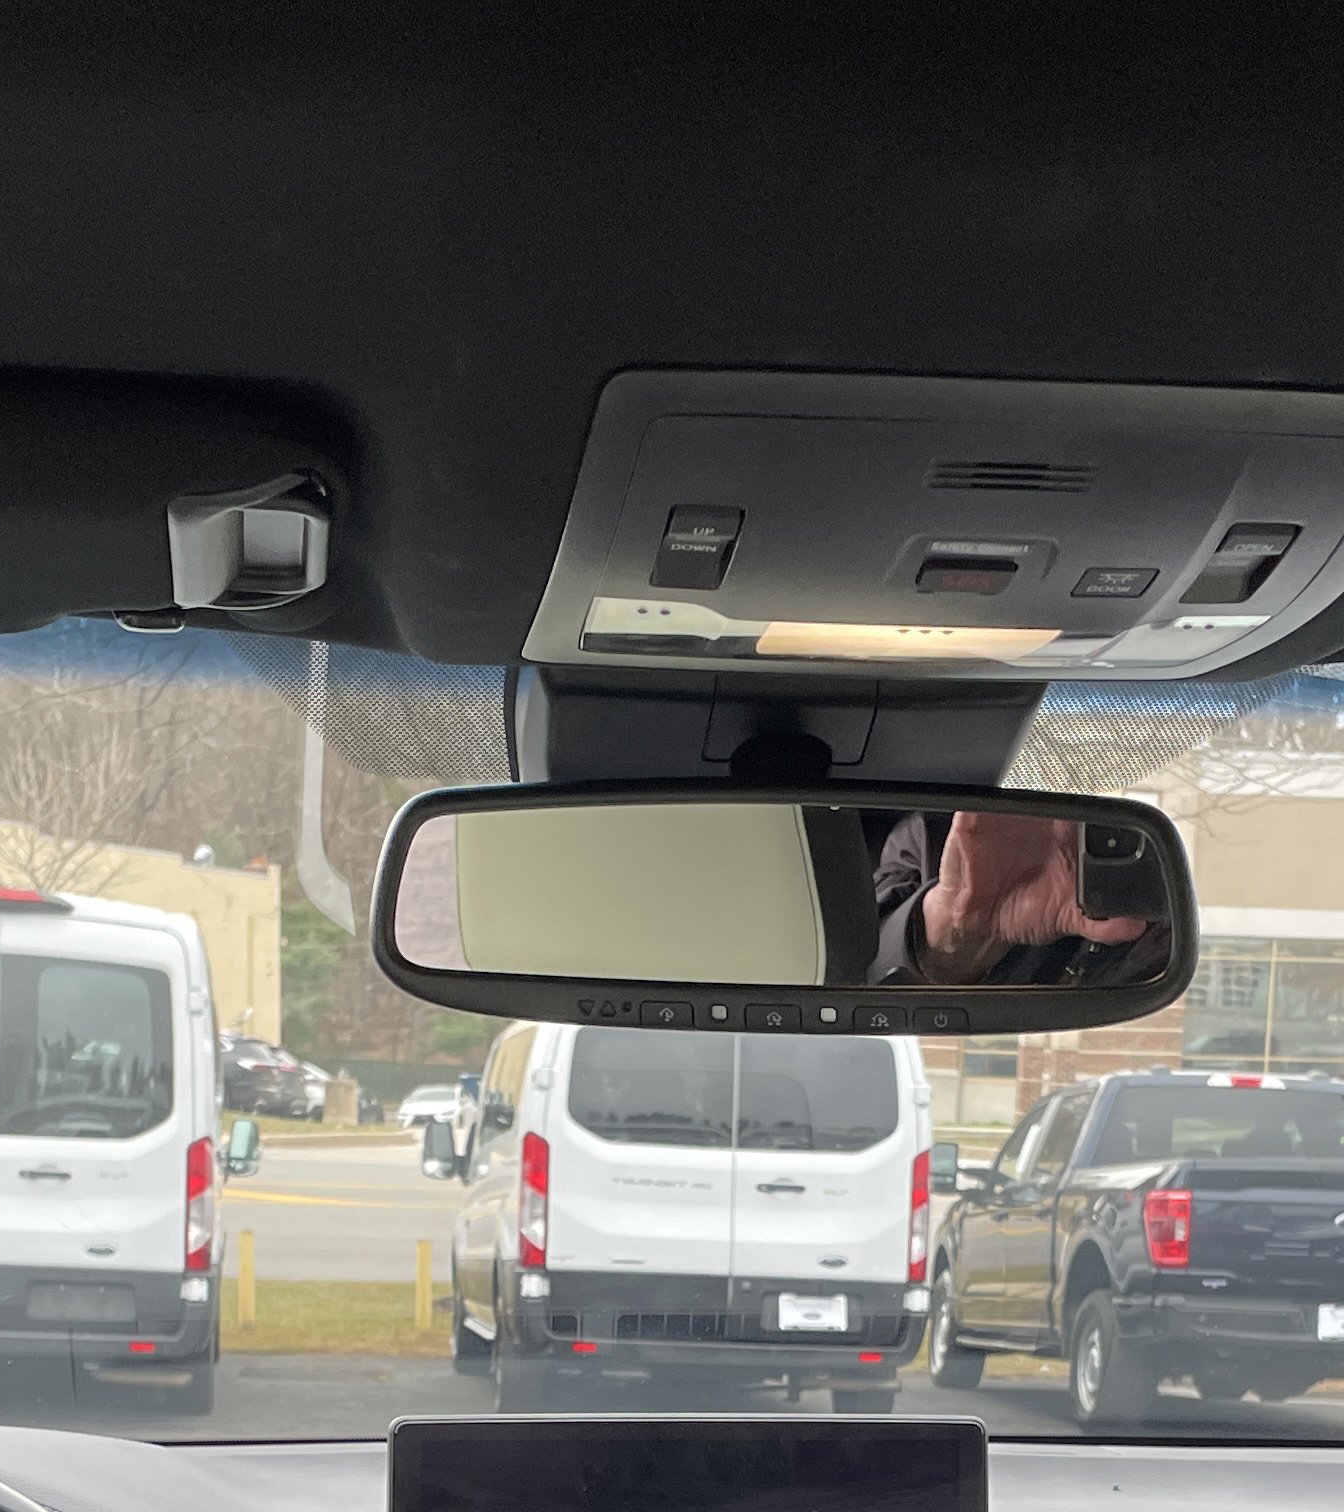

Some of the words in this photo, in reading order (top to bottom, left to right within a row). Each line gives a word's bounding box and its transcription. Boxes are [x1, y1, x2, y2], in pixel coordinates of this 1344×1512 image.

[693, 527, 715, 536] UP
[671, 544, 716, 552] DOWN
[1235, 543, 1274, 551] OPEN
[1086, 585, 1132, 593] DOOR
